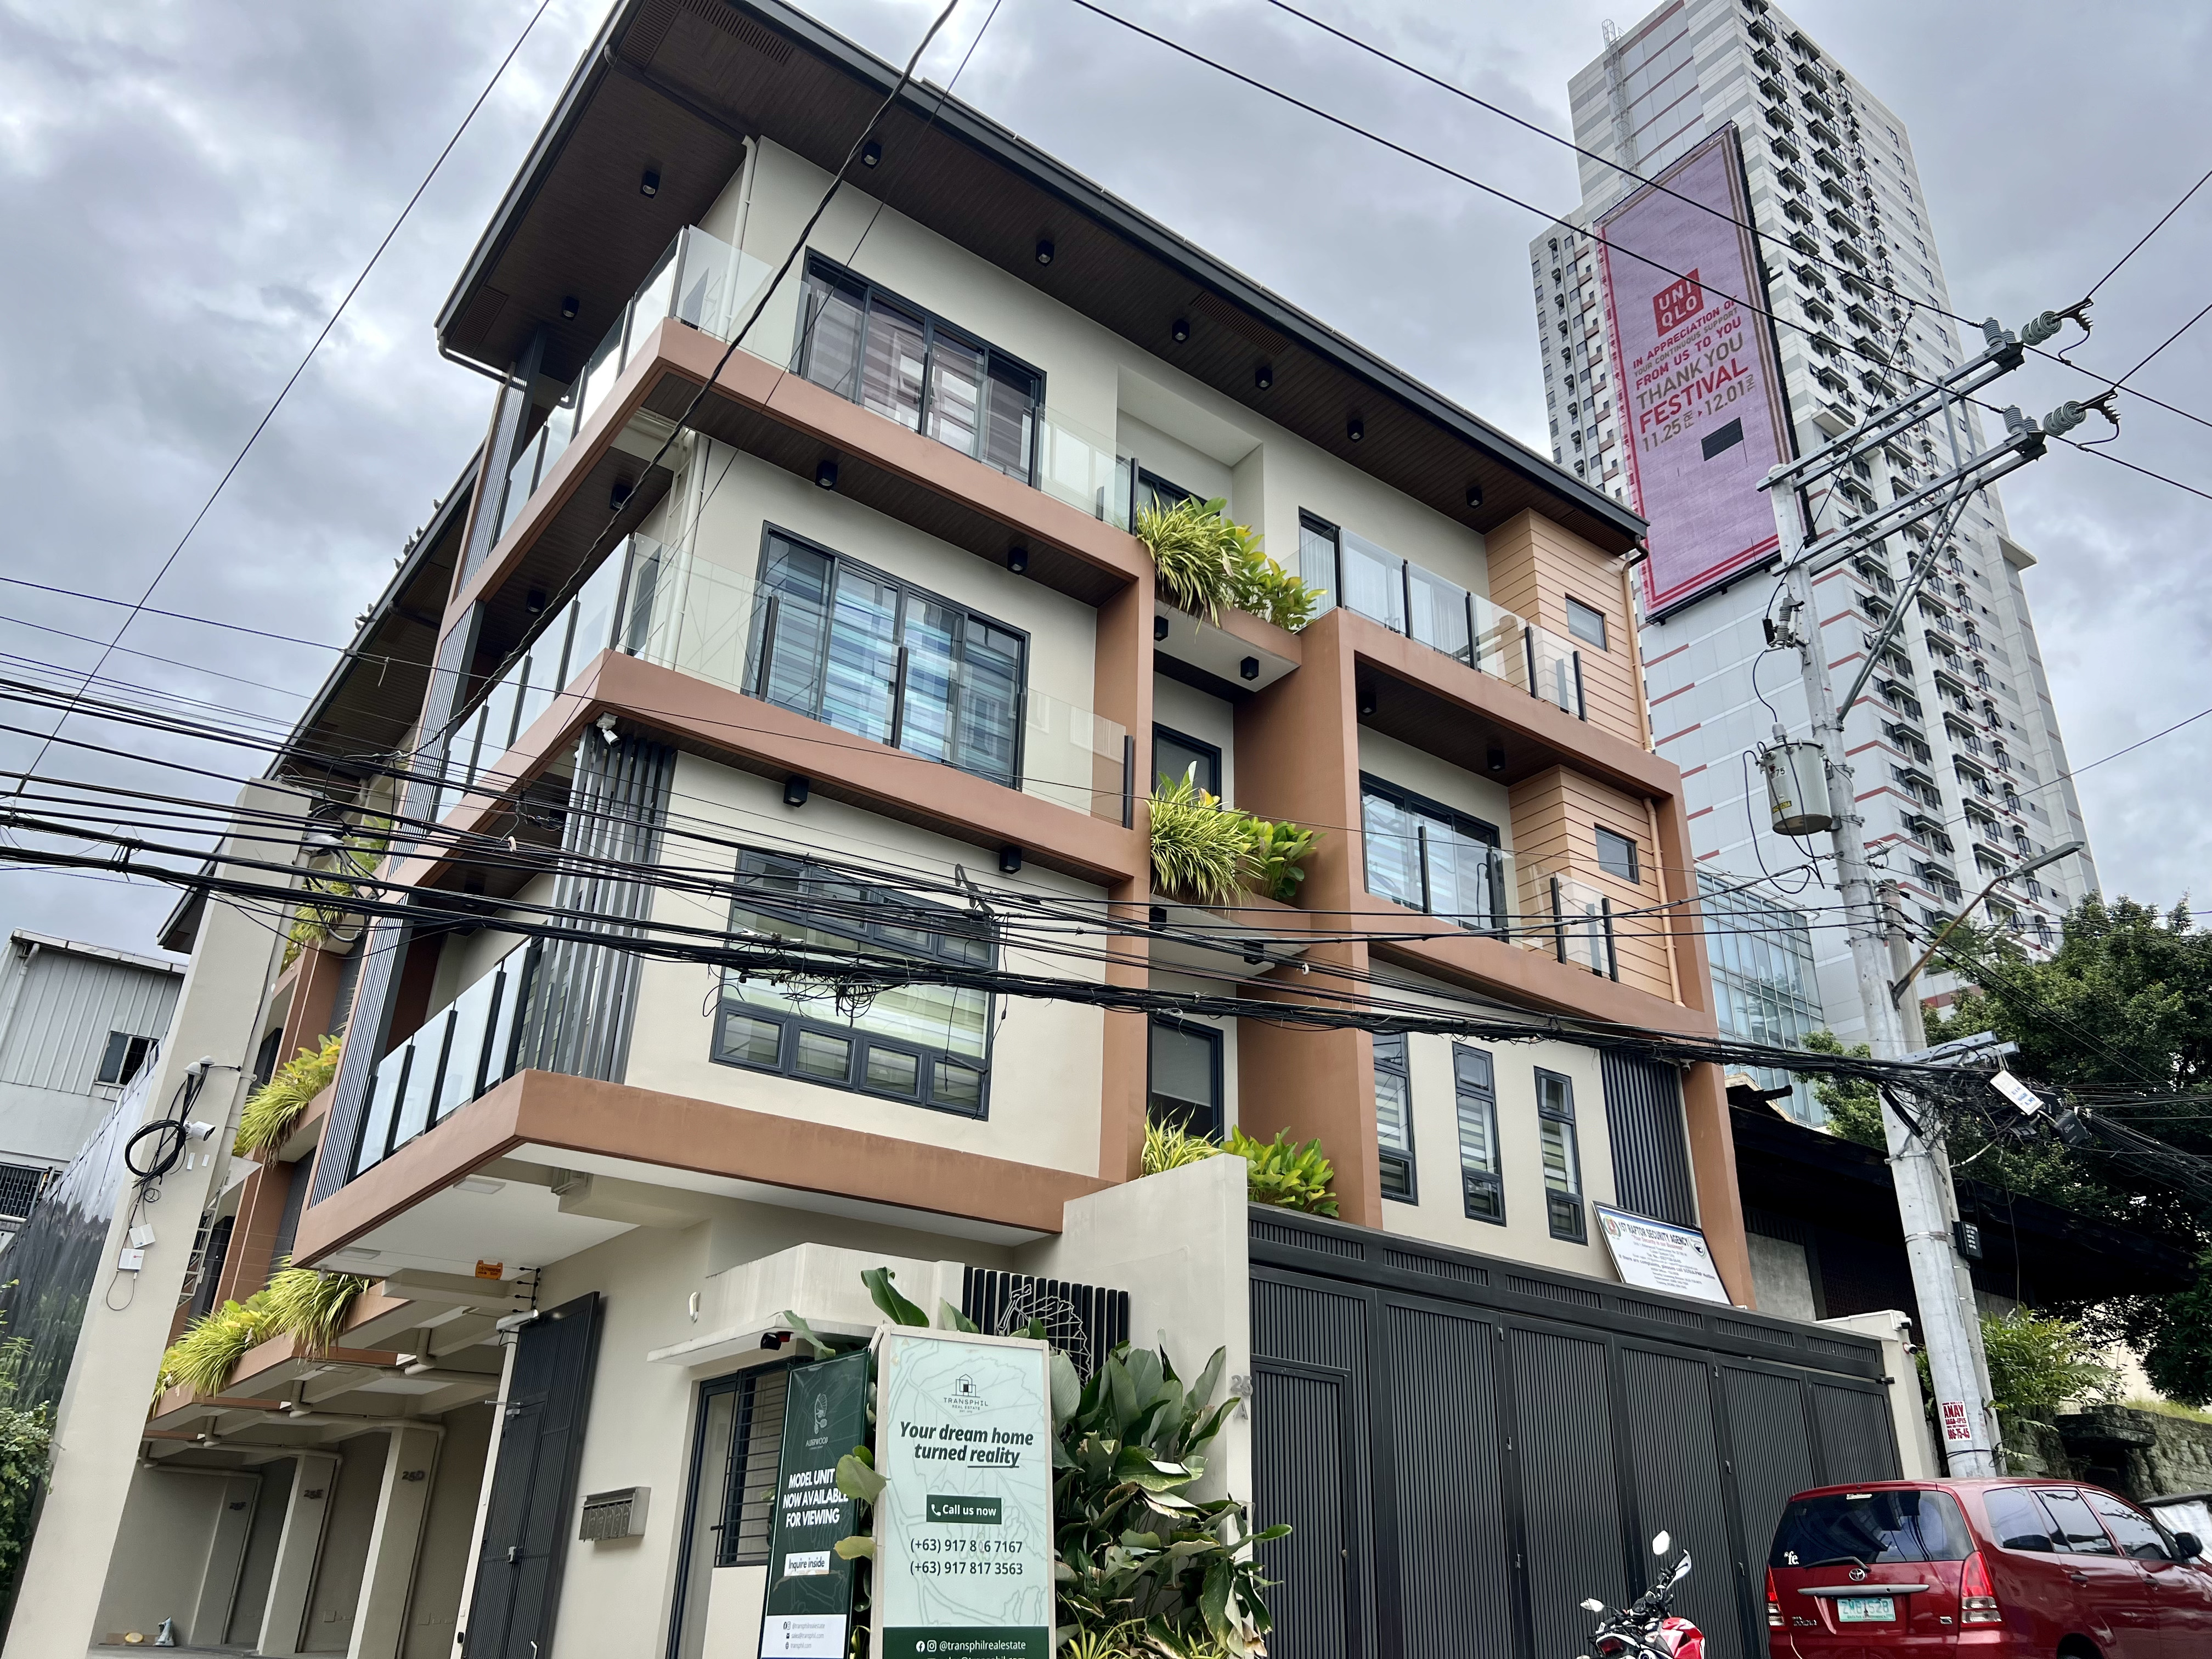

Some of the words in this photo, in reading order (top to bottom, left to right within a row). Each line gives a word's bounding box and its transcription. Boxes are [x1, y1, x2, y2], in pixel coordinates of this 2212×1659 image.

[1658, 280, 1692, 311] UNI
[1661, 295, 1697, 328] QLO
[1633, 357, 1643, 369] IN
[1647, 307, 1720, 360] APPRECIATION
[1634, 362, 1653, 377] YOUR
[1656, 331, 1701, 364] CONTINUOUS
[1703, 307, 1737, 333] SUPPORT
[1636, 362, 1669, 391] FROM
[1674, 349, 1690, 365] US
[1695, 336, 1712, 352] TO
[1716, 316, 1741, 338] YOU
[1636, 357, 1703, 410] THANK
[1704, 331, 1743, 367] YOU
[1640, 358, 1748, 434] FESTIVAL
[1643, 418, 1681, 452] 11.25
[1683, 410, 1694, 429] FRI
[1705, 380, 1744, 415] 12.01
[1745, 374, 1755, 392] THU
[1627, 1224, 1646, 1237] RAPTOR
[1646, 1228, 1670, 1243] SECURITY
[1670, 1234, 1689, 1246] AGENCY
[1231, 1375, 1254, 1396] 25
[944, 1397, 988, 1407] TRANSPHIL
[1233, 1400, 1249, 1420] A
[1943, 1404, 1964, 1418] ANAY
[900, 1421, 936, 1440] Your
[939, 1424, 988, 1443] dream
[991, 1427, 1034, 1446] home
[915, 1443, 968, 1461] turned
[970, 1447, 1020, 1468] reality
[788, 1471, 812, 1489] MODEL
[815, 1468, 836, 1486] UNIT
[783, 1491, 803, 1509] NOW
[802, 1487, 849, 1506] AVAILABLE
[786, 1511, 802, 1528] FOR
[803, 1508, 840, 1526] VIEWING
[943, 1504, 960, 1515] Call
[963, 1507, 974, 1515] us
[976, 1508, 996, 1516] now
[911, 1538, 941, 1553] (+63)
[945, 1539, 966, 1551] 917
[995, 1541, 1023, 1553] 7167
[788, 1558, 807, 1570] Inquire
[808, 1556, 825, 1568] inside
[910, 1561, 941, 1576] (+63)
[944, 1561, 966, 1574] 917
[969, 1562, 991, 1575] 817
[995, 1562, 1023, 1575] 3563
[939, 1640, 1026, 1652] @transphilrealestate
